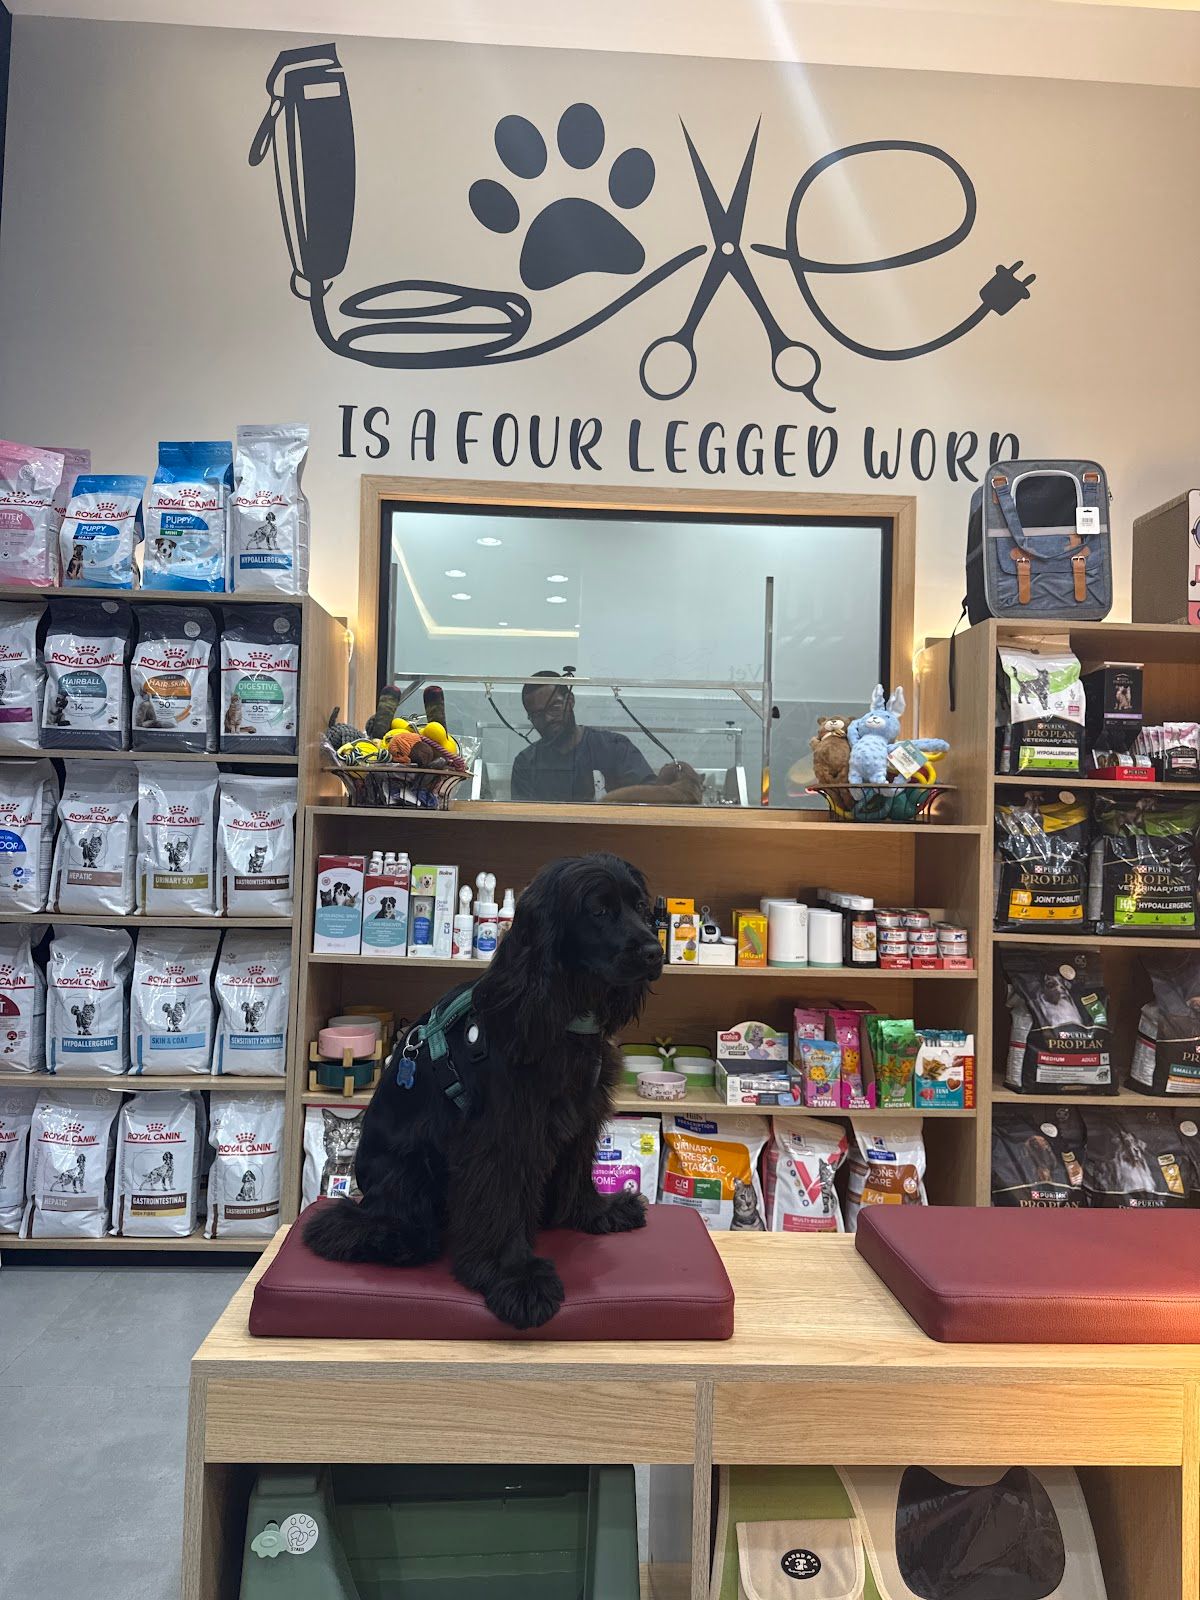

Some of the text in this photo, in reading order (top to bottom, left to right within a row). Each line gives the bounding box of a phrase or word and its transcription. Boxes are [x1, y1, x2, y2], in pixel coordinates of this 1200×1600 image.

[338, 405, 1021, 483] IS A FOUR LEGGED WORD
[157, 498, 216, 508] ROYAL CANIN
[236, 496, 259, 506] ROYAL
[0, 512, 23, 521] ITTEN
[75, 510, 130, 519] ROYAL CANIN
[166, 515, 192, 524] PUPPY
[51, 652, 115, 665] ROYAL CANIN
[140, 656, 202, 668] ROYAL CANIN
[228, 658, 290, 670] ROYAL CANIN
[62, 677, 101, 685] HAIRBALL
[238, 682, 279, 690] DIGESTIVE
[1026, 729, 1076, 739] PRO PLAN
[1022, 737, 1061, 745] VETERINARY
[69, 812, 94, 821] ROYAL
[152, 814, 201, 824] ROYAL CANIN
[232, 818, 283, 828] ROYAL CANIN
[69, 872, 93, 881] HEPATIC
[155, 876, 182, 885] URINARY
[1021, 874, 1079, 885] PRO PLAN
[1034, 894, 1080, 903] JOINT MOBILIT
[56, 977, 83, 986] ROYAL
[147, 975, 198, 984] ROYAL CANIN
[229, 976, 279, 984] ROYAL CANIN
[63, 1038, 114, 1048] HYPOALLERGENIC
[151, 1036, 165, 1045] SKIN
[172, 1036, 188, 1044] COAT
[1048, 1039, 1104, 1049] PRO PLAN
[1183, 1052, 1200, 1063] PR
[1172, 1066, 1192, 1075] SMALL
[0, 1131, 17, 1140] ANIN
[43, 1131, 69, 1142] ROYAL
[127, 1132, 181, 1141] ROYAL CANIN
[218, 1144, 271, 1153] ROYAL CANIN
[868, 1175, 892, 1187] CARE
[132, 1196, 185, 1205] GASTROINTESTINAL
